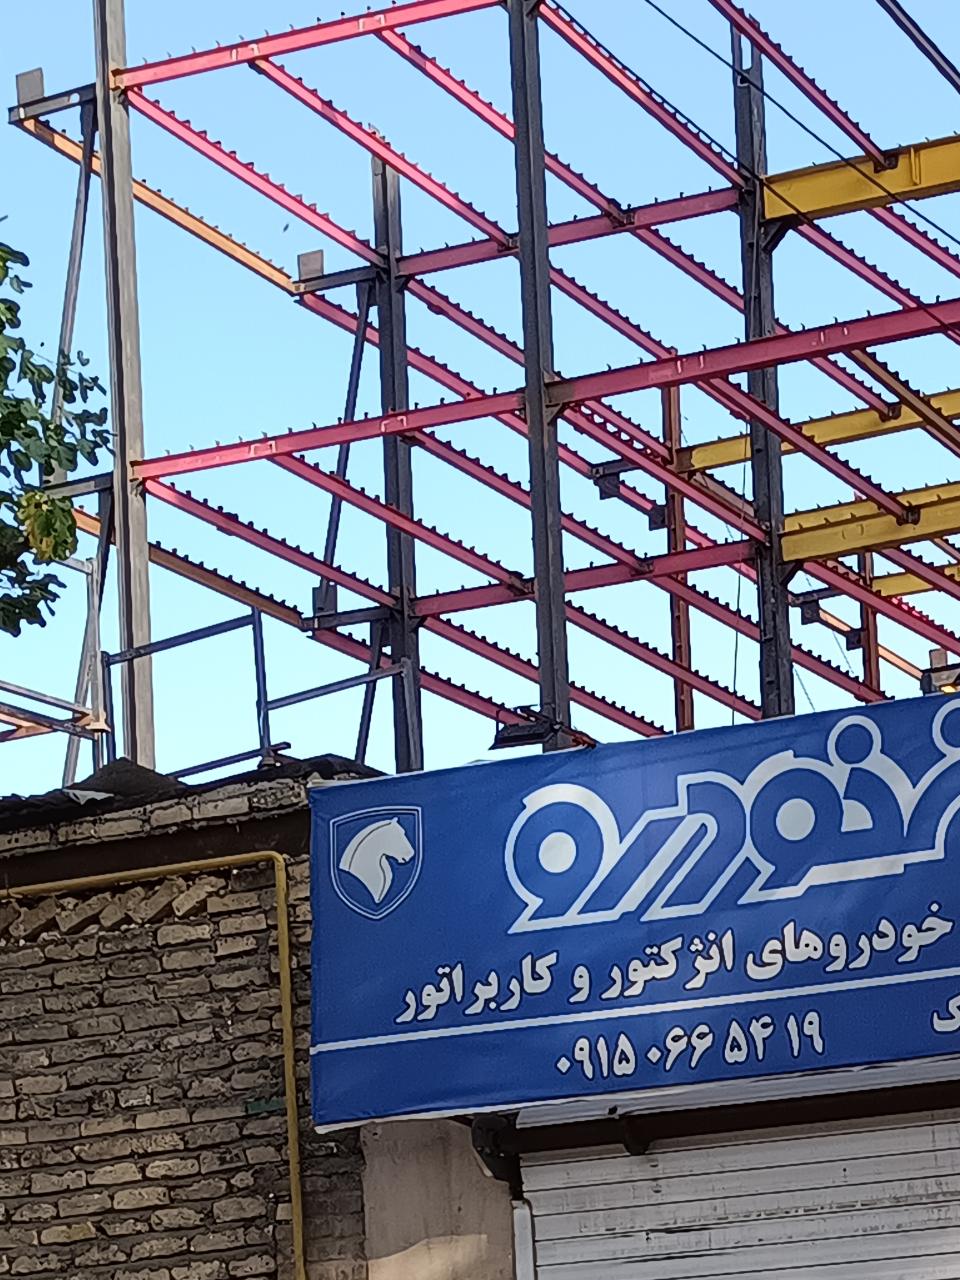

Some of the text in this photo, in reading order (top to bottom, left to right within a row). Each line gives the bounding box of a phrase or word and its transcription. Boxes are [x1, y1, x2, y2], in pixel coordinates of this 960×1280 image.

[601, 929, 734, 999] انژکتور
[745, 902, 953, 980] خودروهای
[396, 953, 557, 1023] کاربراتور
[569, 965, 590, 1003] و
[556, 1033, 636, 1080] ۰۹۱۵
